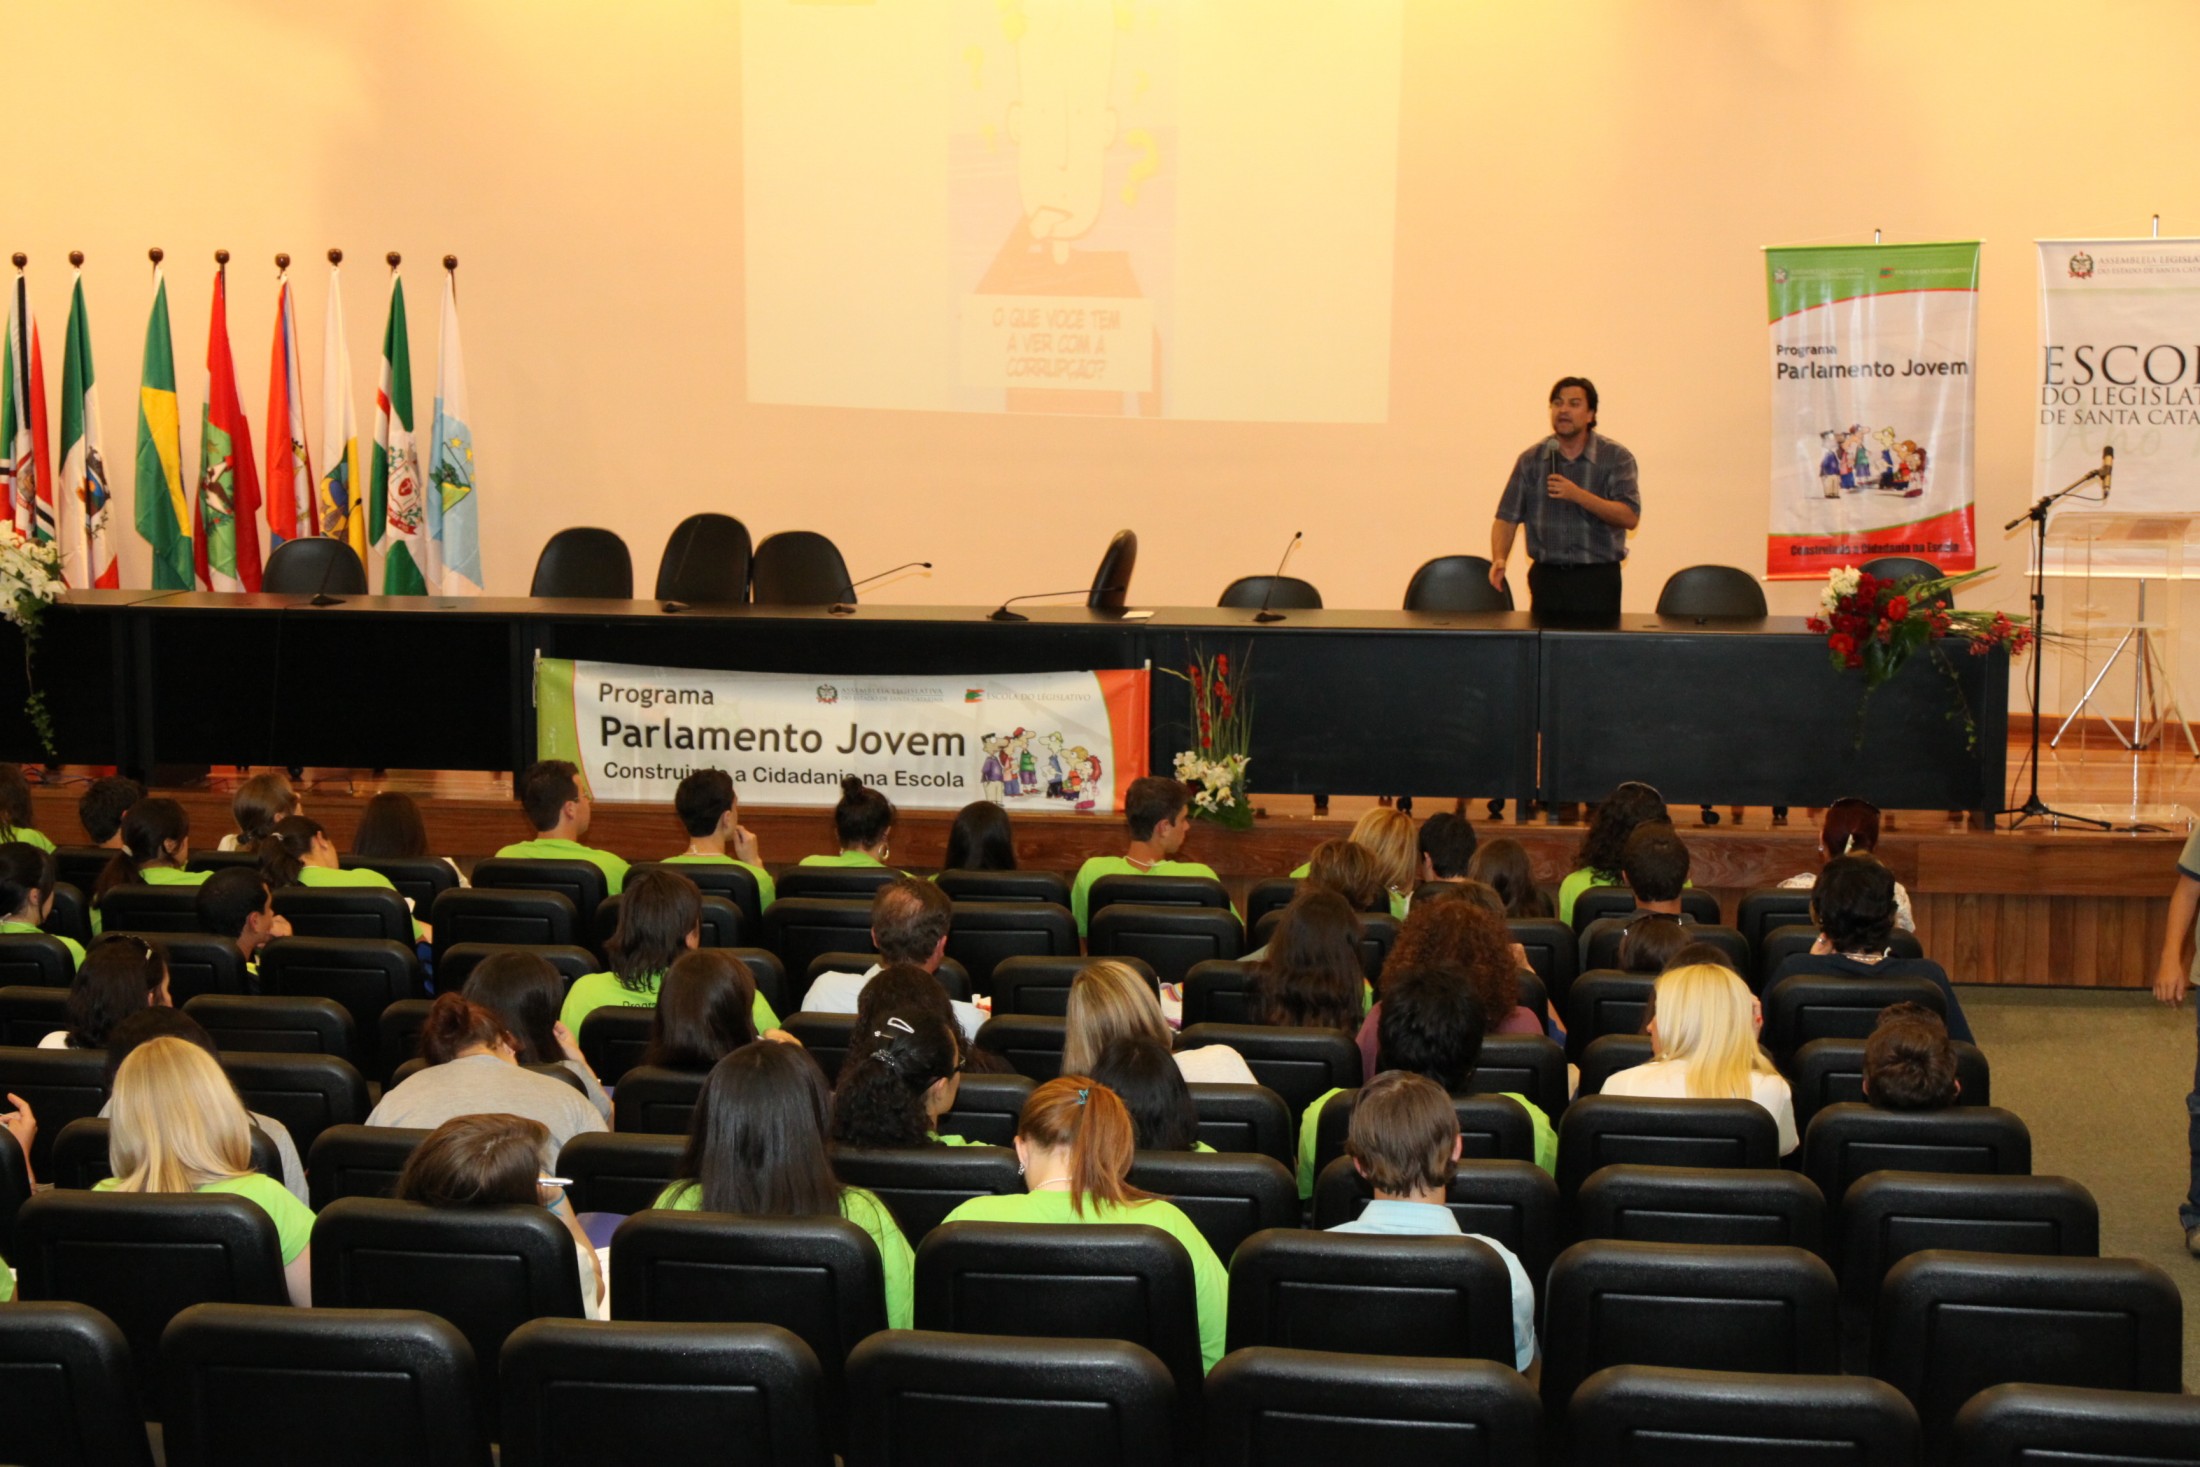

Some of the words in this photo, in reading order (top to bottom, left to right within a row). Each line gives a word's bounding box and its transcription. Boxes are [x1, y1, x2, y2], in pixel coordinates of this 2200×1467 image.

[2159, 255, 2200, 264] LEGISLA
[1009, 308, 1040, 328] QUE
[1091, 310, 1121, 330] TEM
[1022, 332, 1052, 352] VER
[1058, 334, 1090, 353] COM
[1776, 344, 1837, 358] Programa
[1777, 362, 1895, 379] Parlamento
[1901, 359, 1969, 377] Jovem
[2043, 345, 2200, 385] ESCO
[2042, 386, 2081, 405] DO
[2040, 409, 2066, 425] DE
[2074, 409, 2141, 425] SANTA
[2147, 409, 2200, 425] CATA
[599, 683, 714, 709] Programa
[601, 716, 823, 753] Parlamento
[836, 723, 965, 757] Jovem
[603, 762, 728, 780] Construi
[735, 770, 746, 782] a
[863, 773, 888, 786] na
[895, 771, 964, 787] Escola
